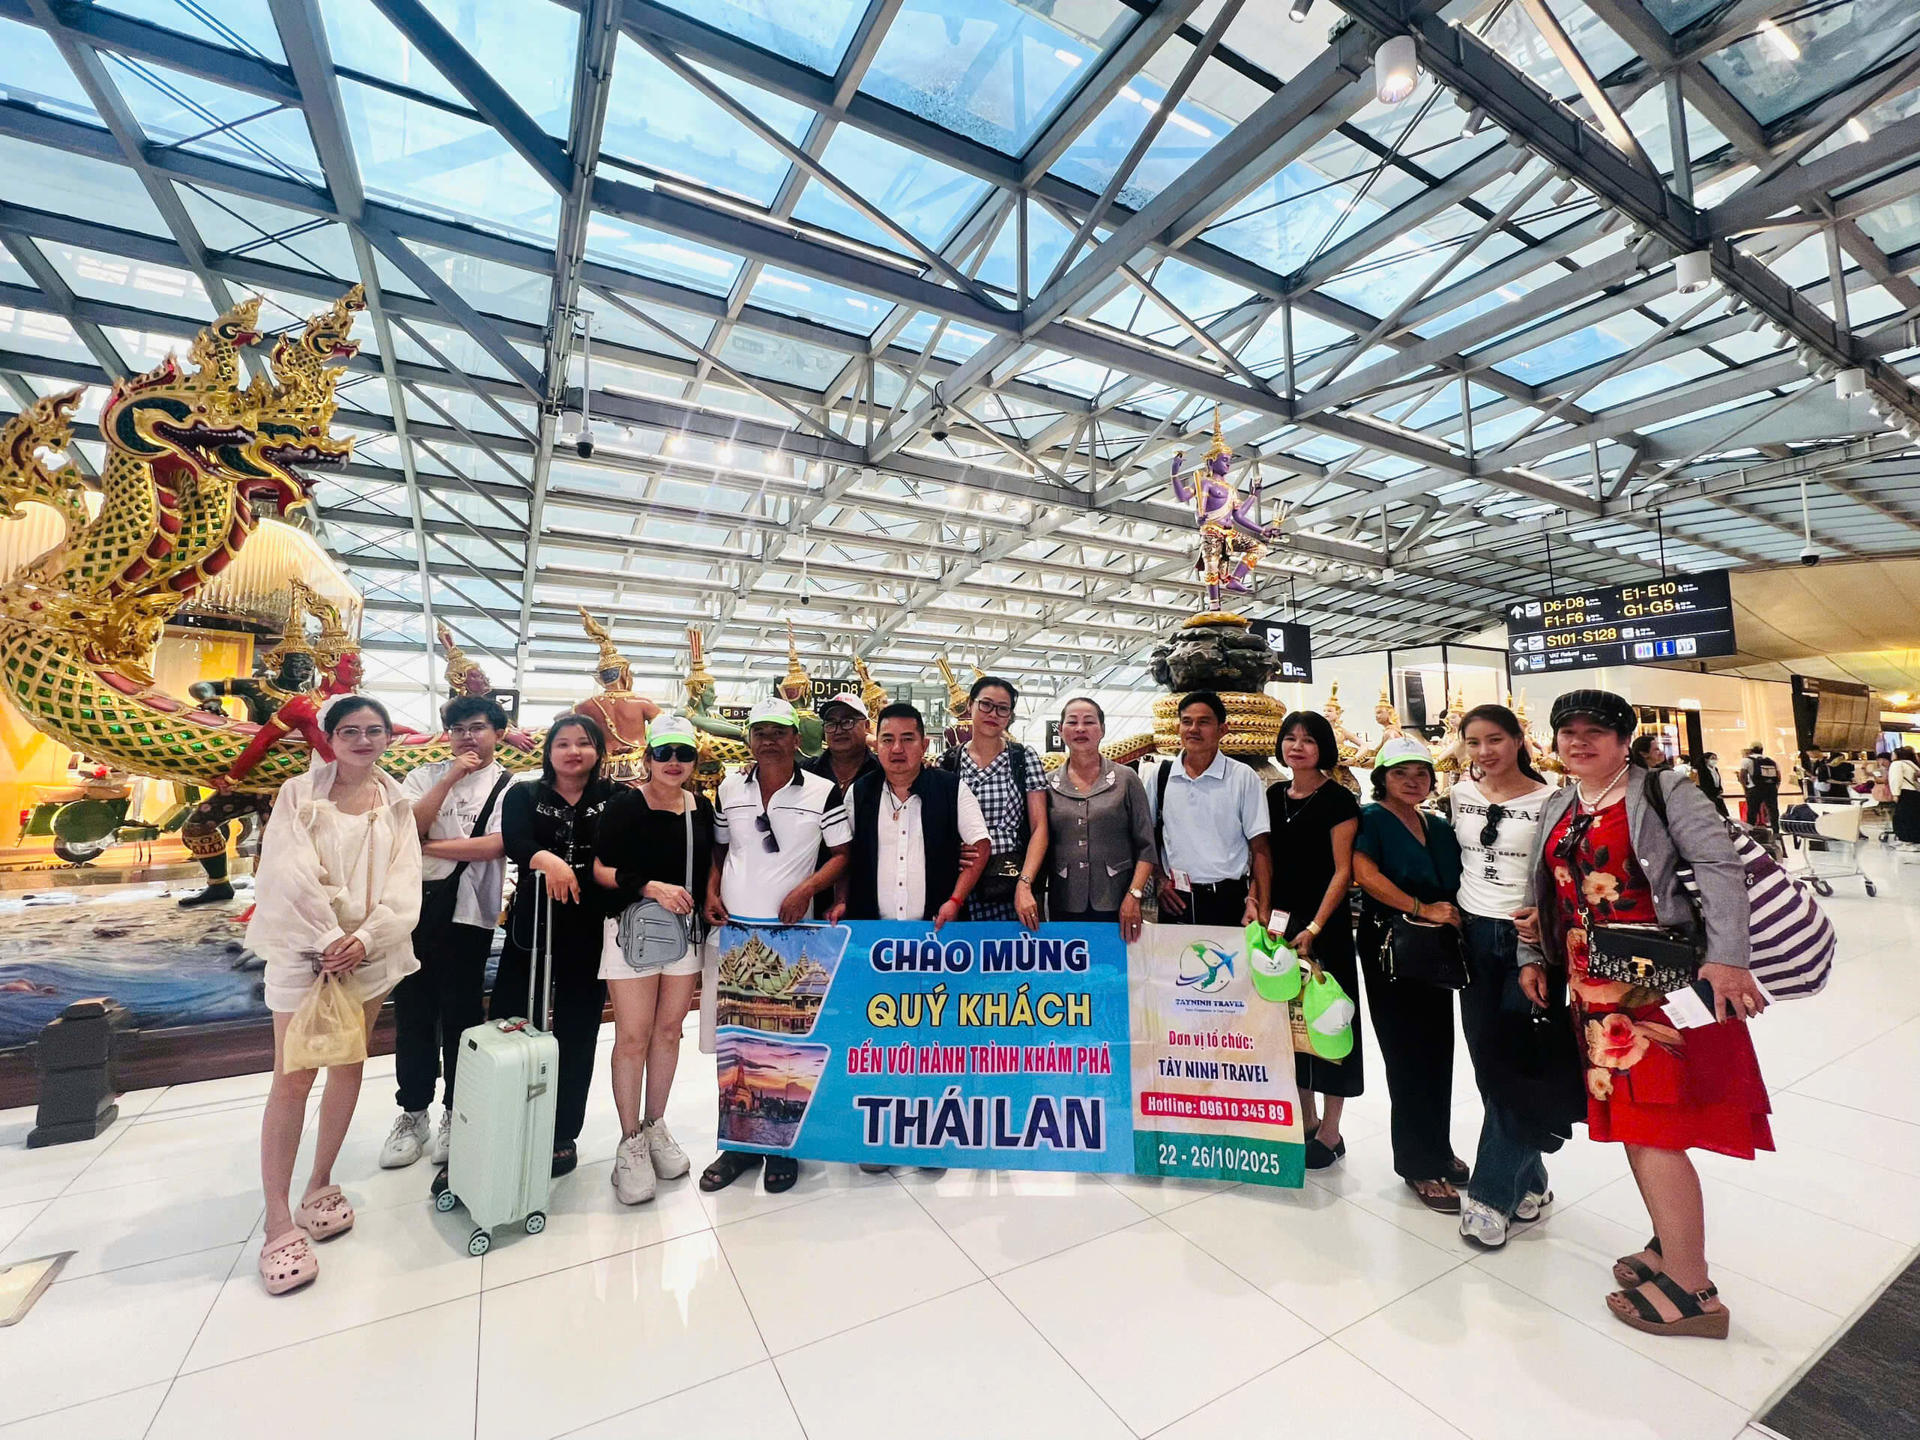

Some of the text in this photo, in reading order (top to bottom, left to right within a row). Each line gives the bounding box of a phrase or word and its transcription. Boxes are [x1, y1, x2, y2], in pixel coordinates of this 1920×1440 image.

[1622, 582, 1676, 600] E1-E10
[1543, 596, 1585, 613] D6-D8
[1623, 599, 1674, 616] G1-G5
[1544, 612, 1584, 628] F1-F6
[1546, 627, 1617, 647] S101-S128
[871, 933, 1088, 972] CHÀO MỪNG
[867, 983, 1092, 1027] QUÝ KHÁCH
[1213, 1000, 1245, 1008] TRAVEL
[1169, 1029, 1254, 1050] Đơn vị tổ chức:
[848, 1039, 1111, 1075] ĐẾN VỚI HÀNH TRÌNH KHÁM PHÁ
[1158, 1056, 1269, 1083] TÂY NINH TRAVEL
[1148, 1096, 1286, 1121] Hotline: 09610 345 89
[995, 1097, 1102, 1149] LAN
[1158, 1143, 1178, 1165] 22
[1191, 1146, 1280, 1175] 26/10/2025
